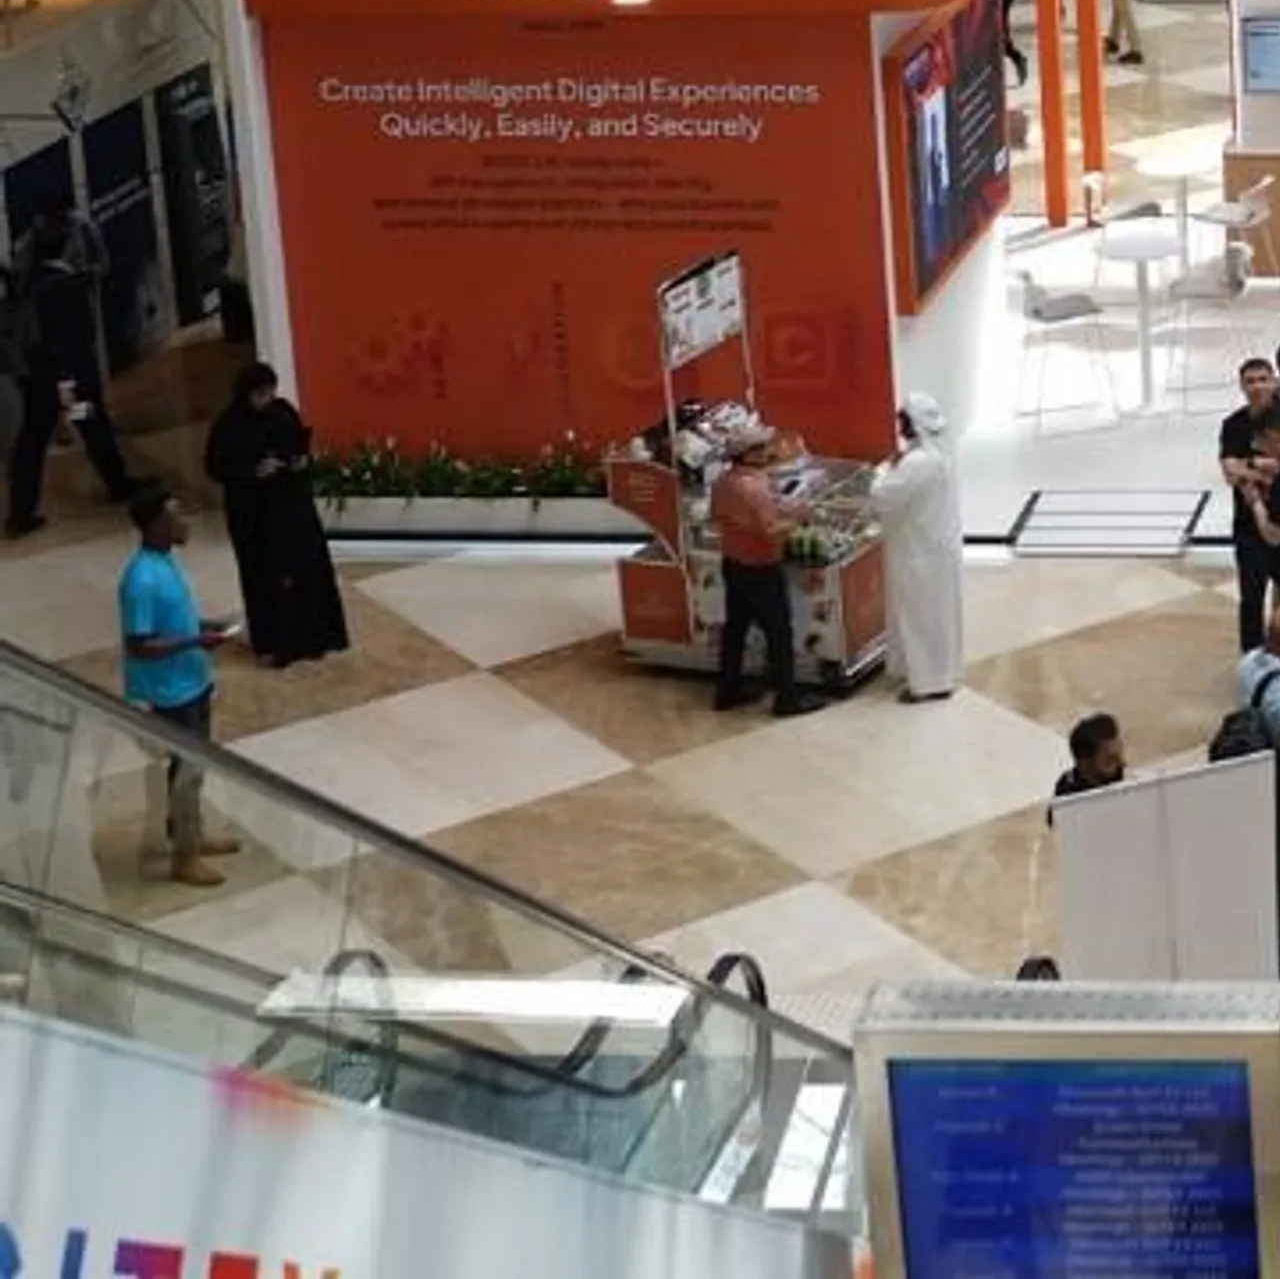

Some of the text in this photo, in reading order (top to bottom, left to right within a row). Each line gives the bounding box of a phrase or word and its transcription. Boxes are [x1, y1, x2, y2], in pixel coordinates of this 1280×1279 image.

[317, 77, 821, 107] Create Intelligent Digital Experiences
[380, 112, 763, 142] Quickly, Easily, and Securely
